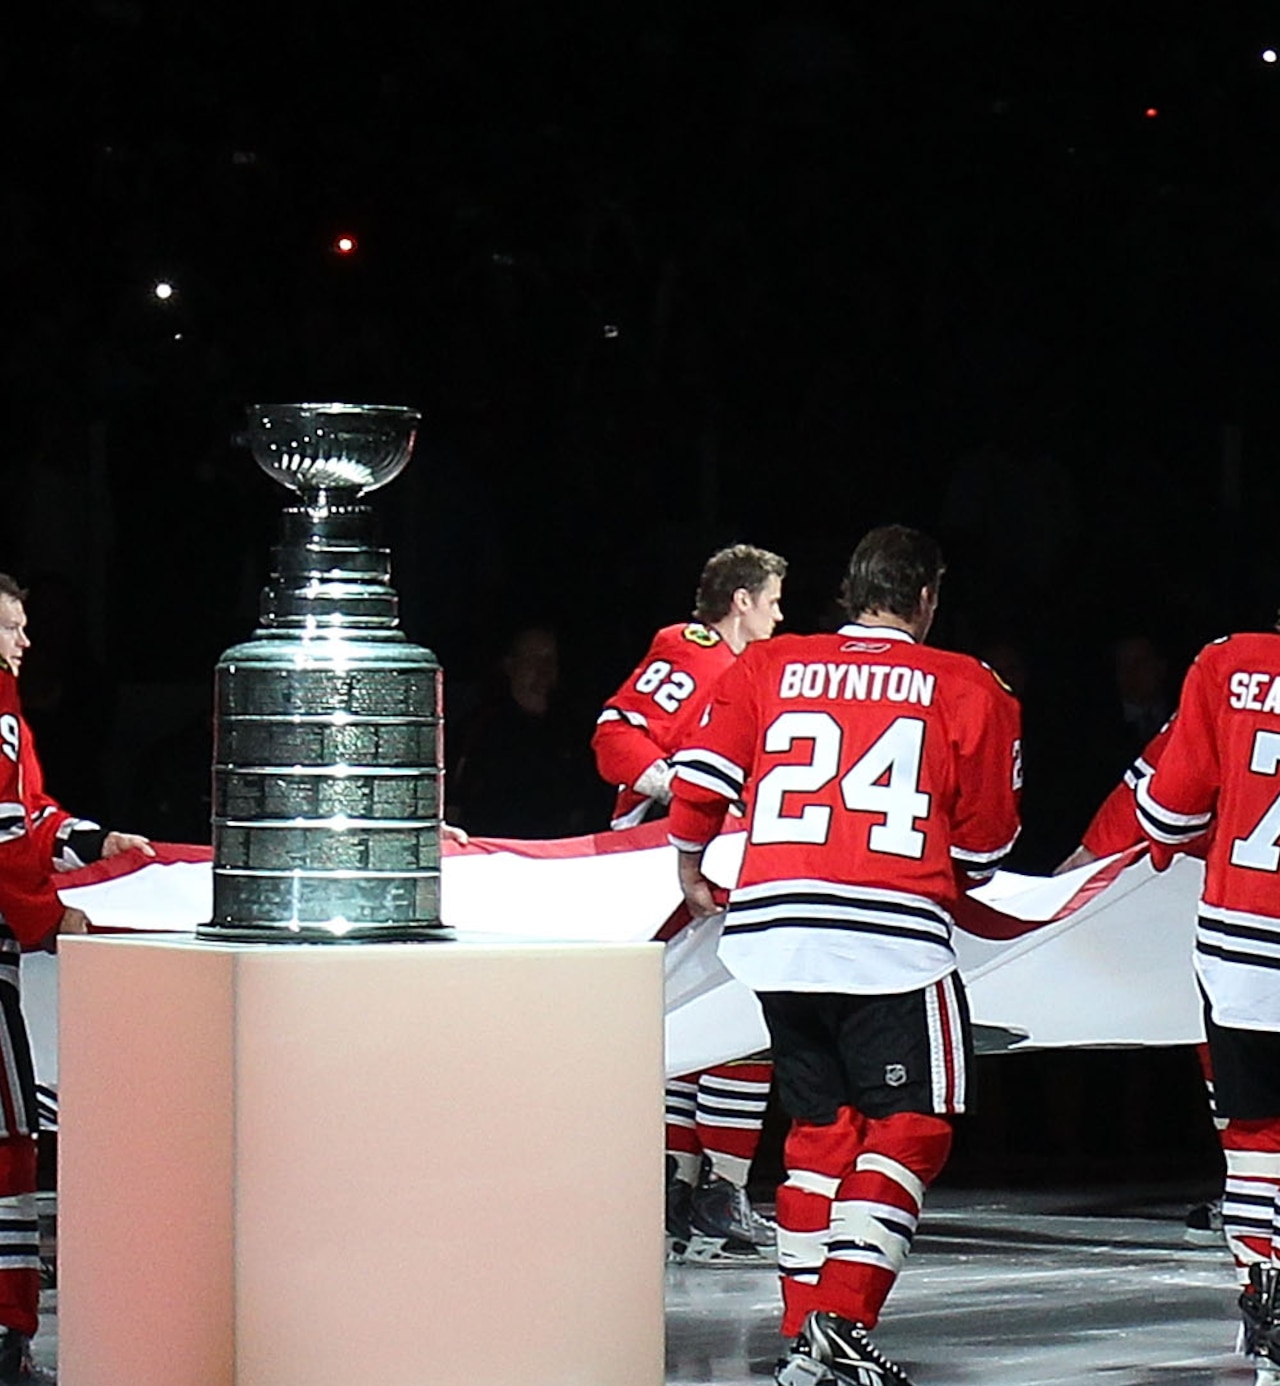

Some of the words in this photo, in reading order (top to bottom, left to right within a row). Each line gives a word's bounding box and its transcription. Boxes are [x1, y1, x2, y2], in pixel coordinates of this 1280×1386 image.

[635, 660, 695, 714] 82
[779, 662, 936, 707] BOYNTON
[750, 710, 932, 860] 24
